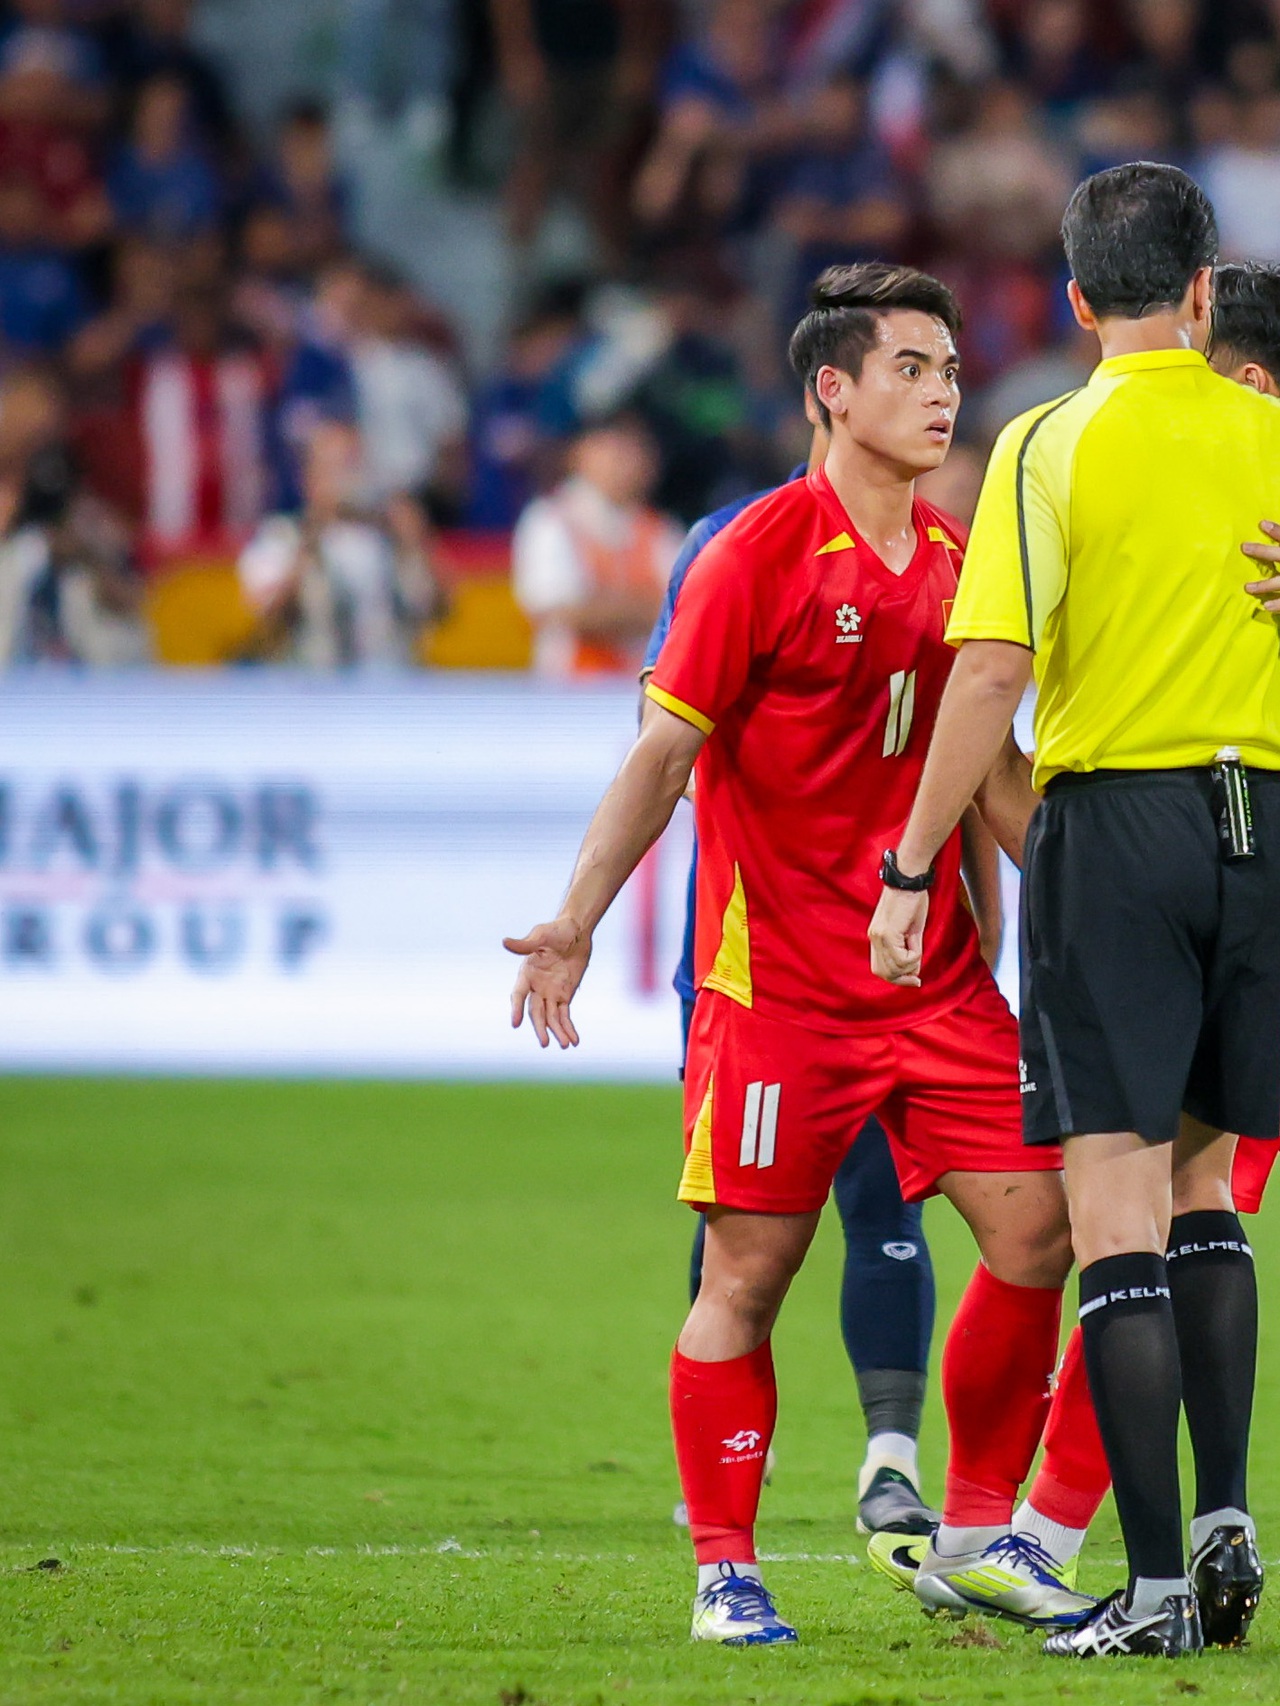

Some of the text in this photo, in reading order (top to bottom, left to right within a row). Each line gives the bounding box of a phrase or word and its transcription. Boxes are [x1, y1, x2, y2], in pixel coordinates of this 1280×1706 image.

[883, 670, 916, 758] 11
[739, 1081, 781, 1169] 11
[1166, 1241, 1240, 1261] KELME
